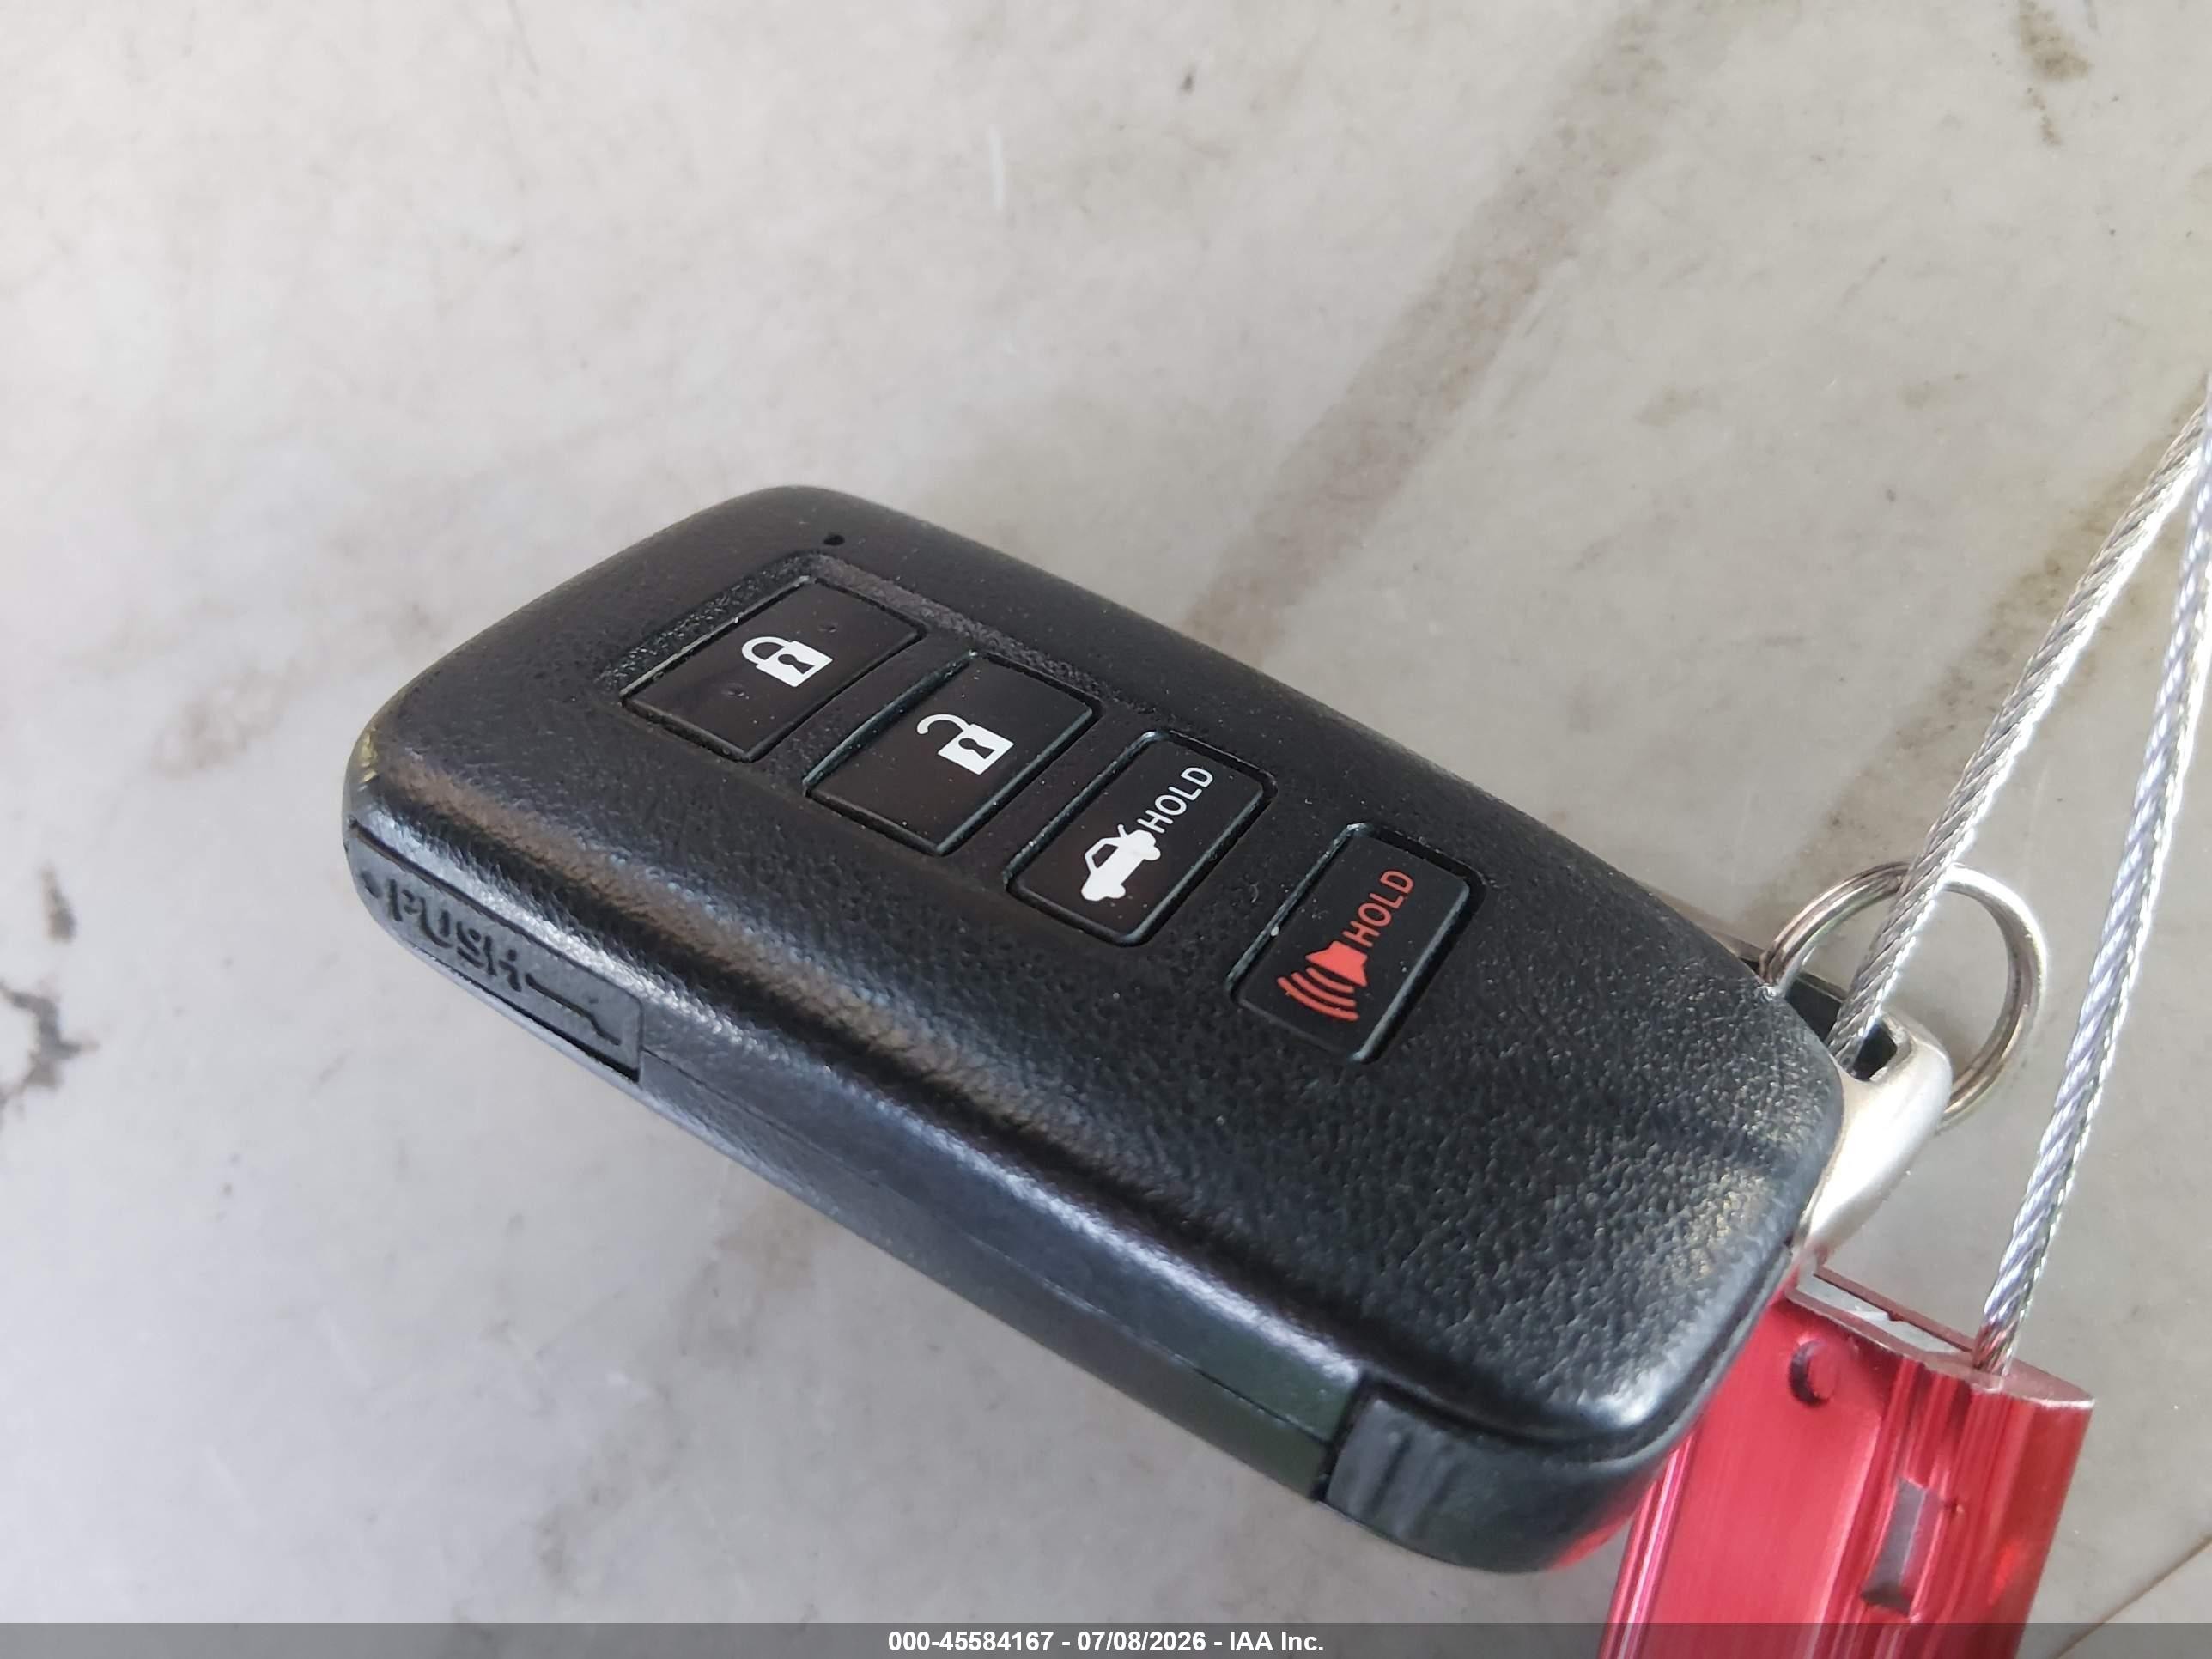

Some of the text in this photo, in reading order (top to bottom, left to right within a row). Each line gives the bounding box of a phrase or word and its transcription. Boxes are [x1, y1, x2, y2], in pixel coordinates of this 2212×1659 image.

[1137, 766, 1214, 834] HOLD
[388, 878, 522, 993] PUSH
[1341, 869, 1415, 948] HOLD
